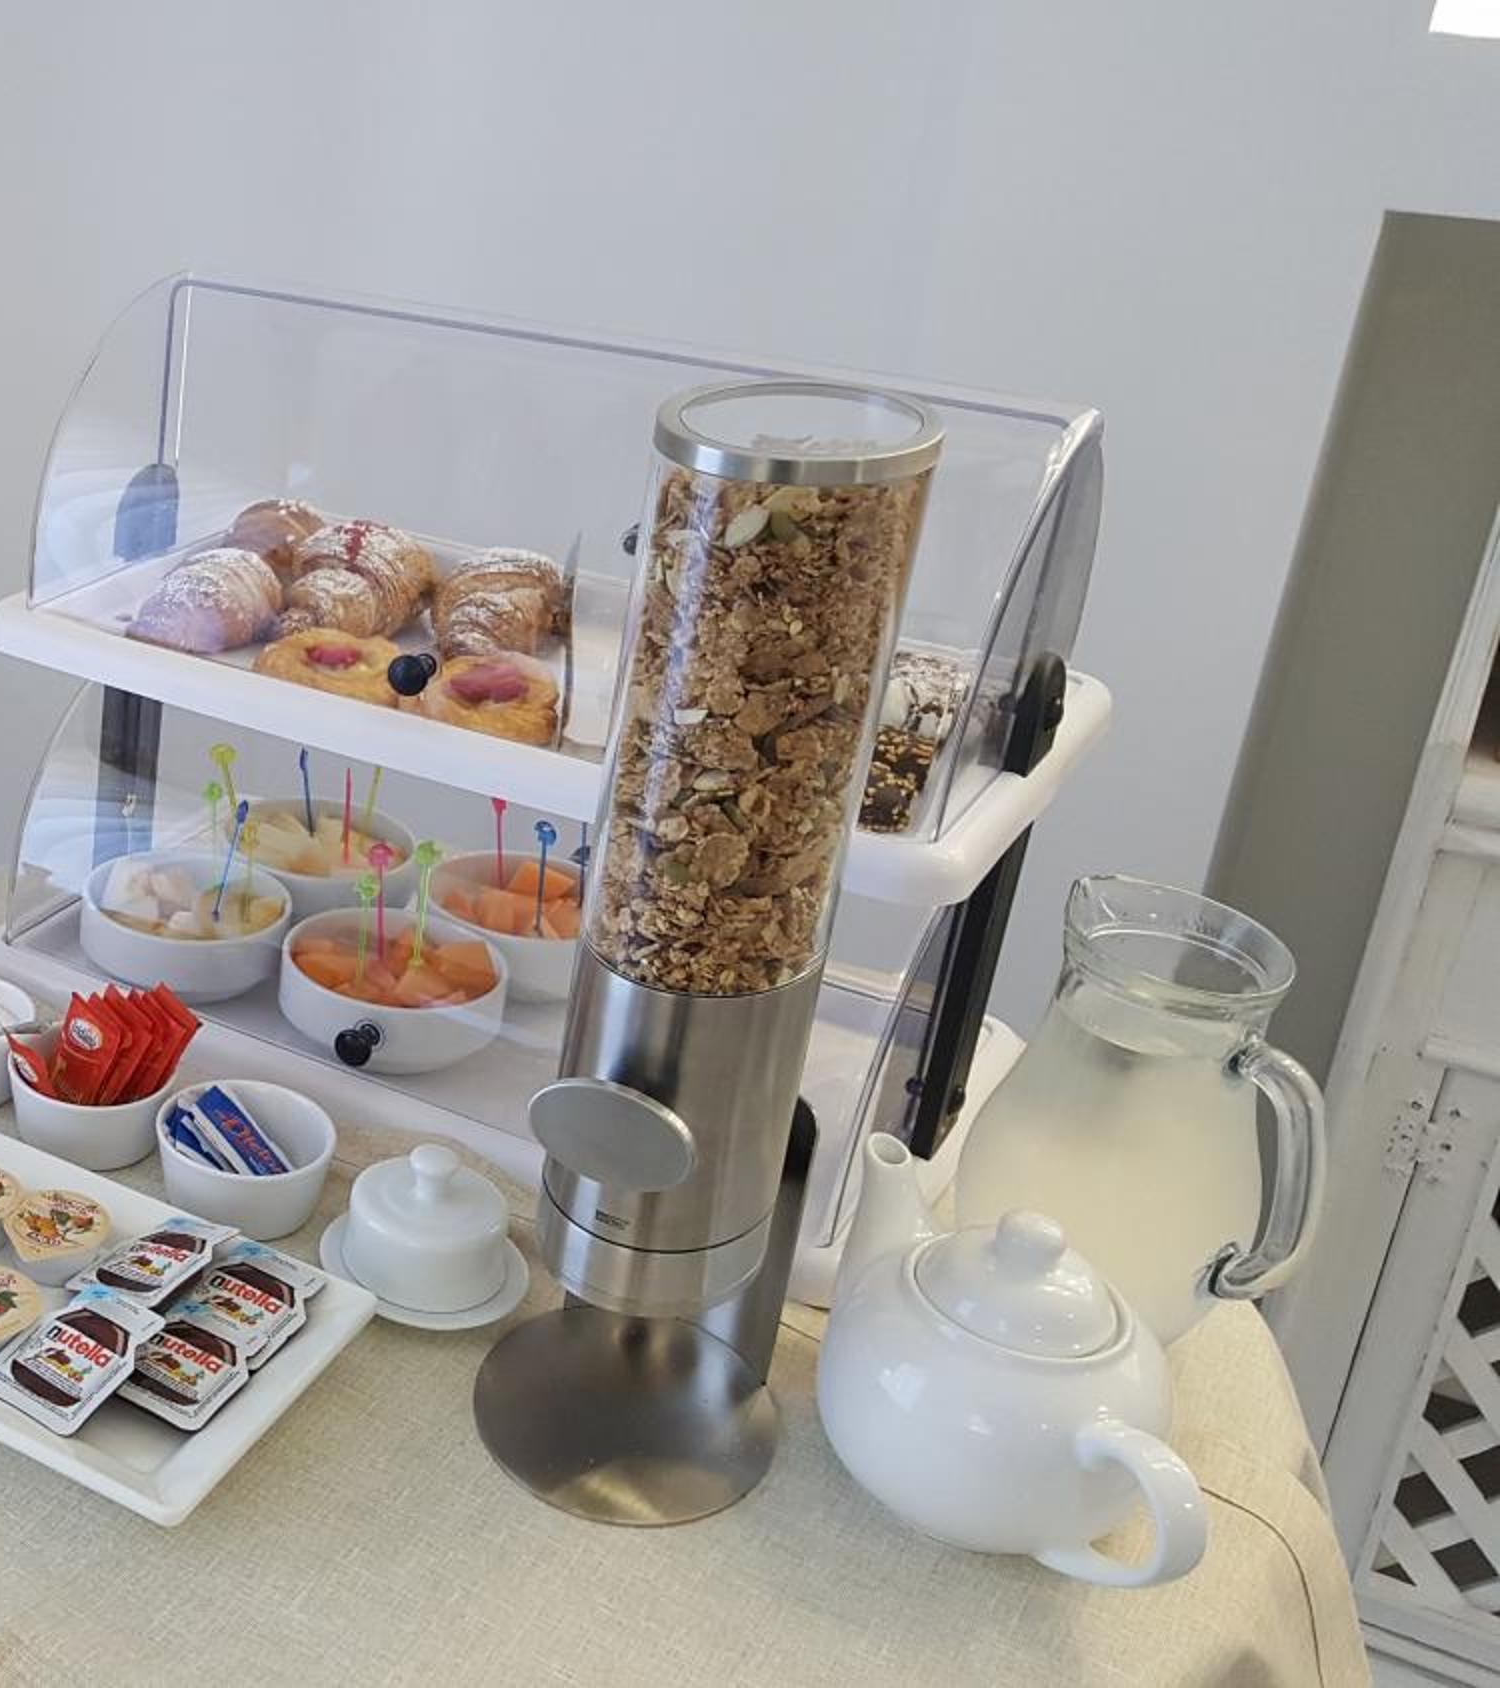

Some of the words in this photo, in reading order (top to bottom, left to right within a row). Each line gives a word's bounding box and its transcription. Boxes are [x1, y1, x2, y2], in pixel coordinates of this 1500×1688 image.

[208, 1275, 282, 1315] nutella
[46, 1324, 112, 1369] nutella
[150, 1332, 224, 1375] nutella
